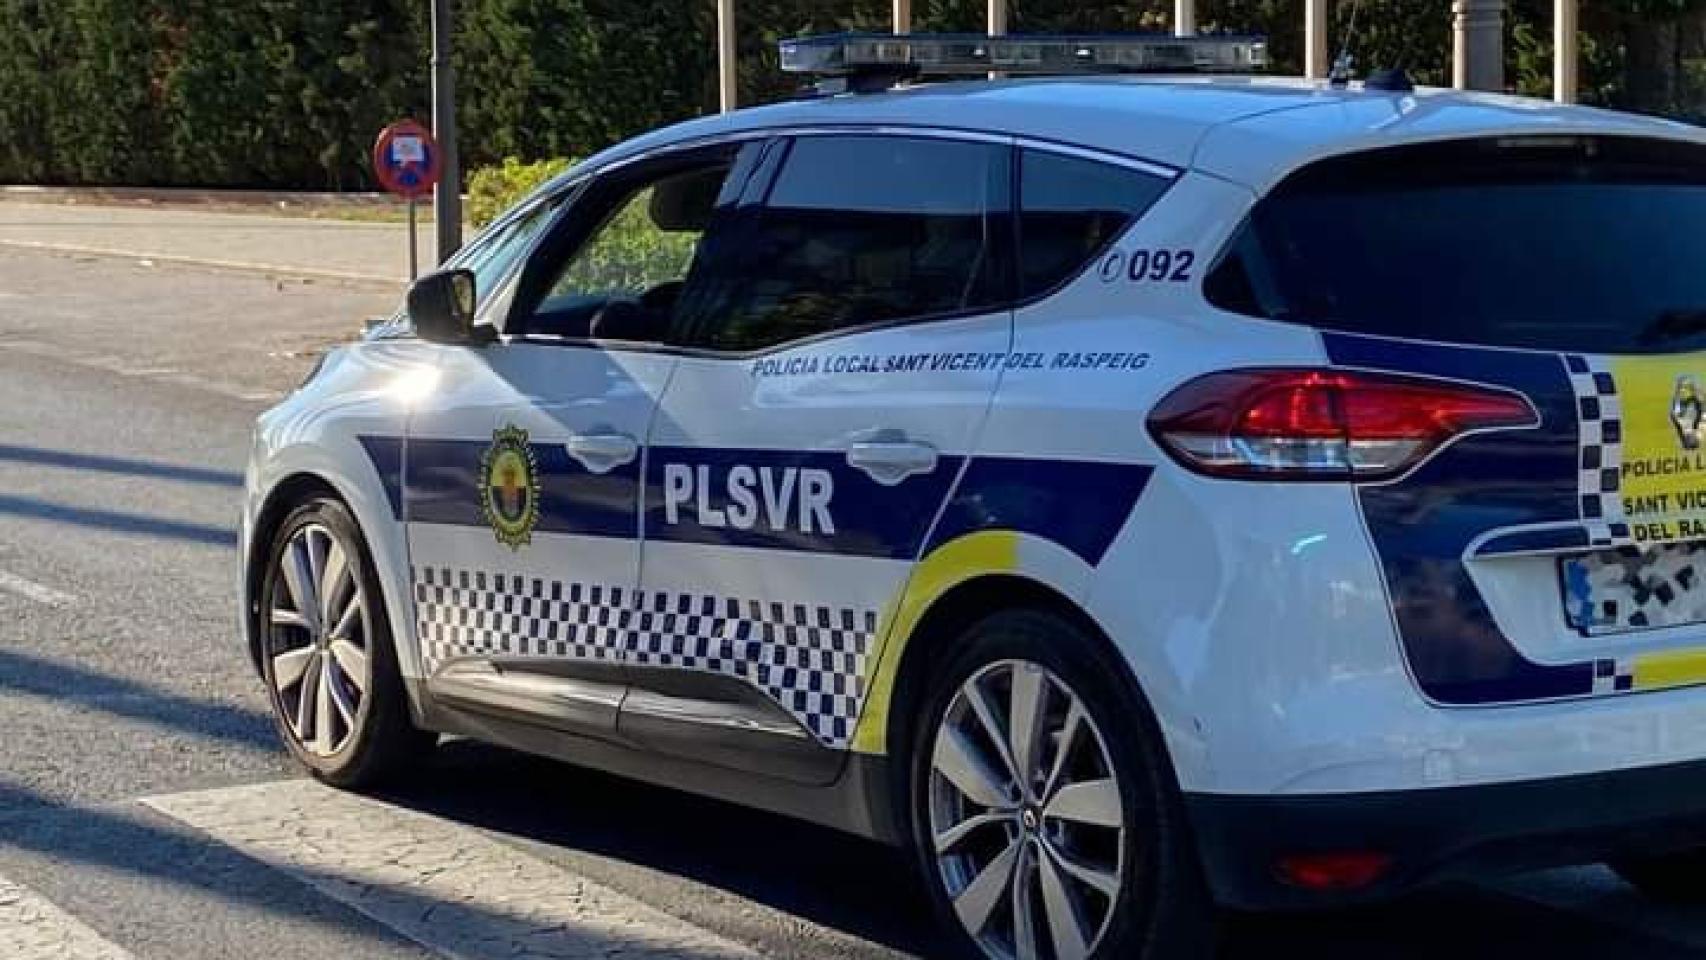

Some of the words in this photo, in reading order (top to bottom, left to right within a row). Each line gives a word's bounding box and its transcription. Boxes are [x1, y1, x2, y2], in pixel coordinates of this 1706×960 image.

[1128, 249, 1195, 282] 092
[752, 357, 818, 377] POLICIA
[822, 354, 880, 373] LOCAL
[883, 353, 930, 373] SANT
[930, 352, 1006, 371] VICENT
[1003, 352, 1044, 369] DEL
[1050, 352, 1150, 370] RASPEIG
[1622, 456, 1690, 479] POLICIA
[664, 463, 835, 536] PLSVR
[1622, 493, 1669, 516] SANT
[1634, 523, 1674, 542] DEL
